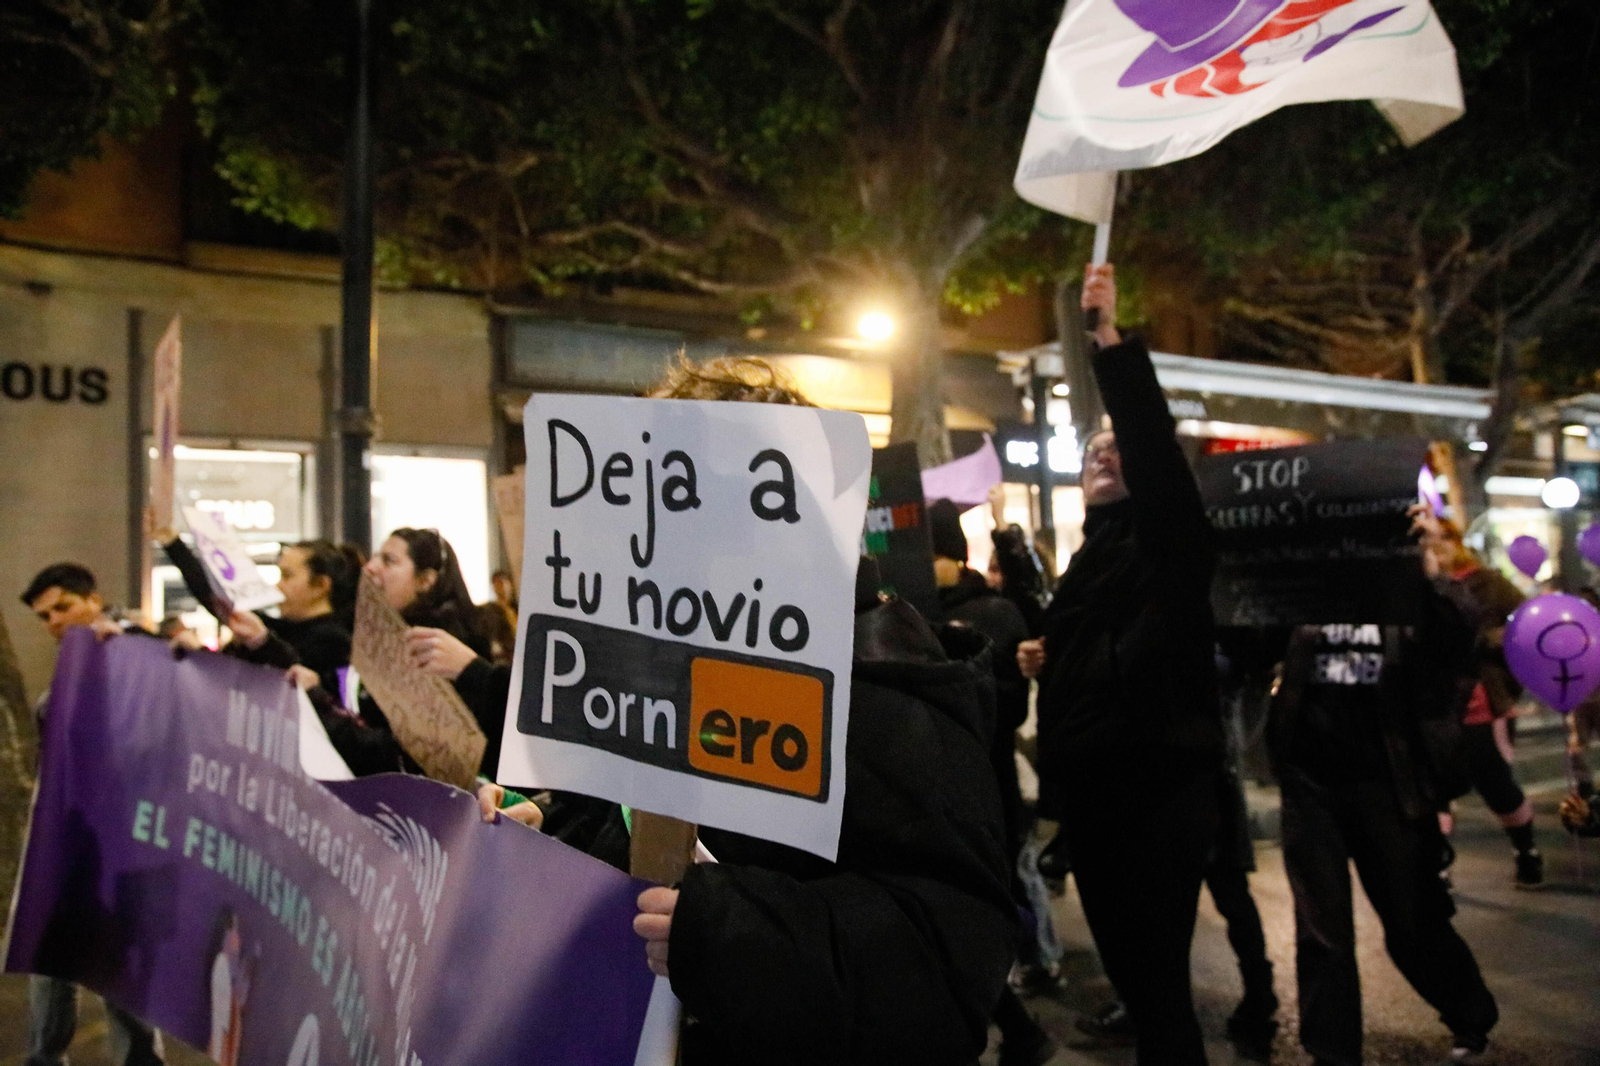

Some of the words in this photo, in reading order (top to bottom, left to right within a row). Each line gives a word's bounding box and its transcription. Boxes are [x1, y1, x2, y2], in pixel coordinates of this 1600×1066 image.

[2, 361, 109, 404] OUS
[546, 418, 702, 568] Deja
[748, 448, 801, 524] a
[1232, 455, 1310, 494] STOP
[545, 529, 602, 615] tu
[627, 574, 810, 653] novio
[131, 799, 171, 850] EL
[182, 816, 312, 946] FEMINISMO
[186, 752, 231, 797] por
[236, 761, 259, 813] la
[263, 778, 377, 913] Liberación
